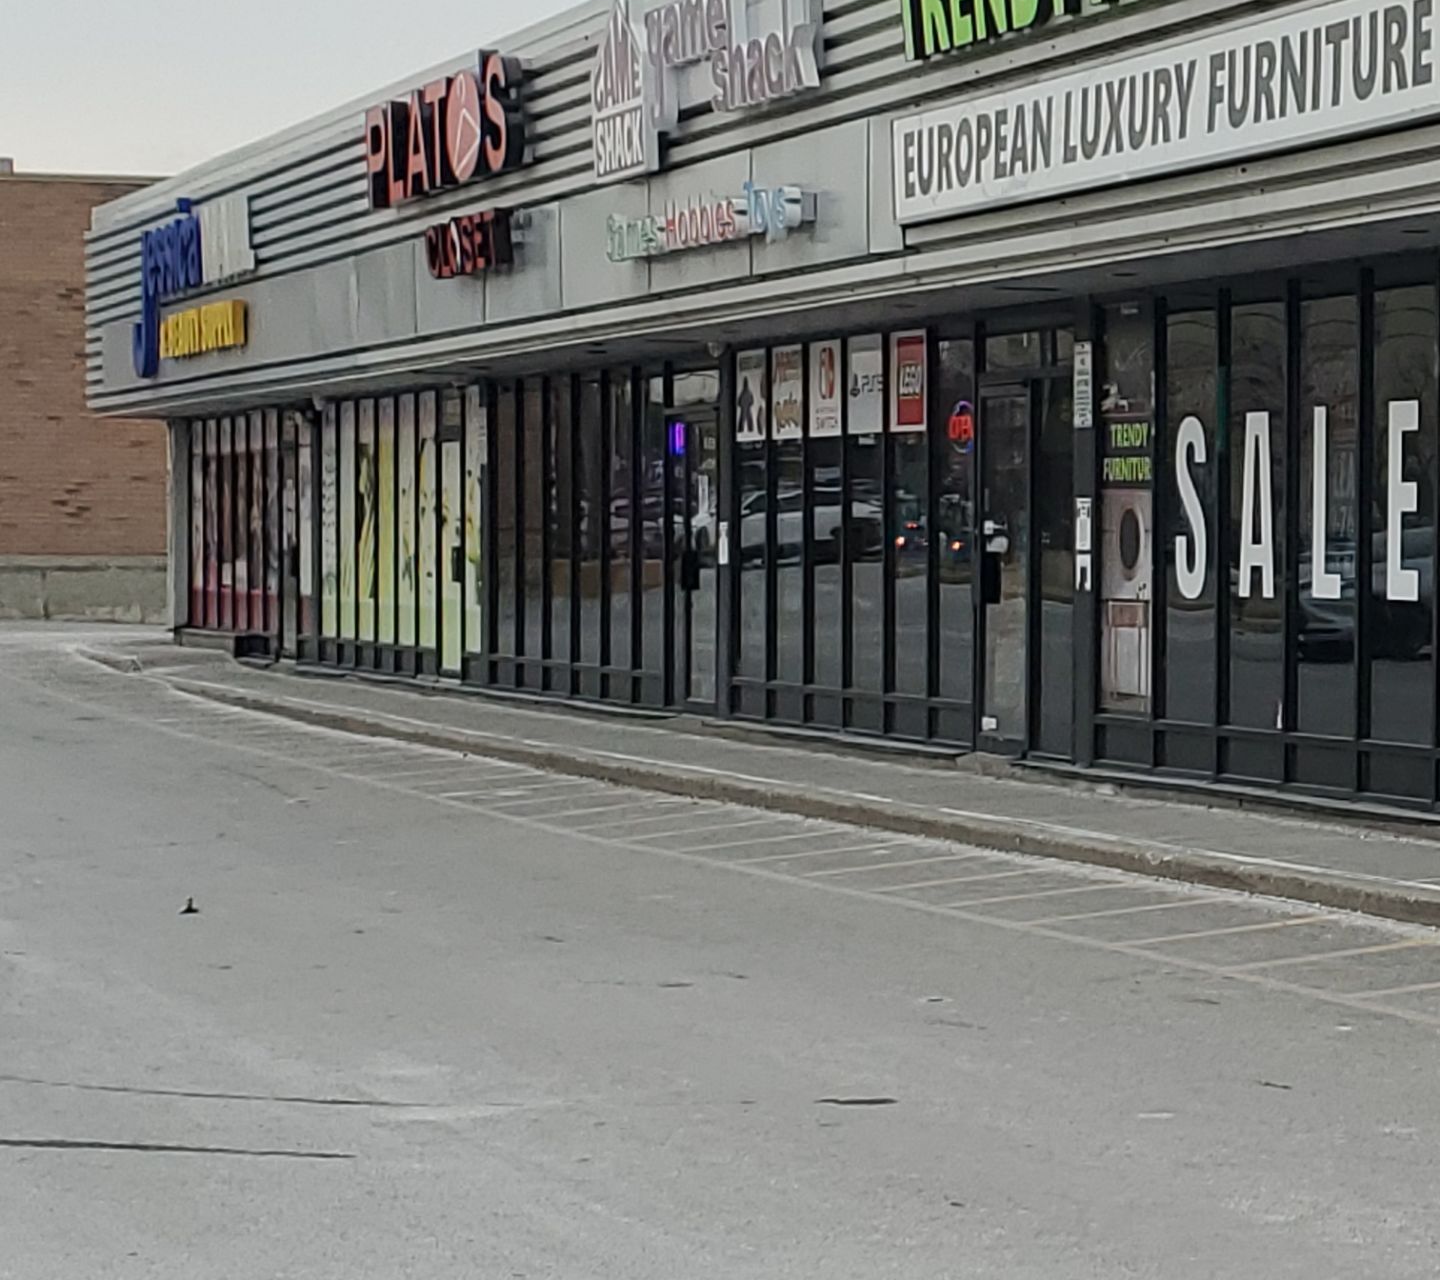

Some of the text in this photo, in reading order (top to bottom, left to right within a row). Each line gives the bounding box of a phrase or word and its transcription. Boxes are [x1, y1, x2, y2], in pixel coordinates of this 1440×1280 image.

[596, 108, 644, 178] SHACK
[903, 96, 1054, 200] EUROPEAN
[1062, 60, 1197, 165] LUXURY
[425, 210, 500, 279] CLOSET
[665, 193, 738, 247] Hobbies
[744, 181, 790, 244] Toys
[132, 197, 202, 378] Jessica
[1103, 457, 1152, 481] FURNITUR
[1110, 423, 1149, 448] TRENDY
[1175, 399, 1420, 600] SALE
